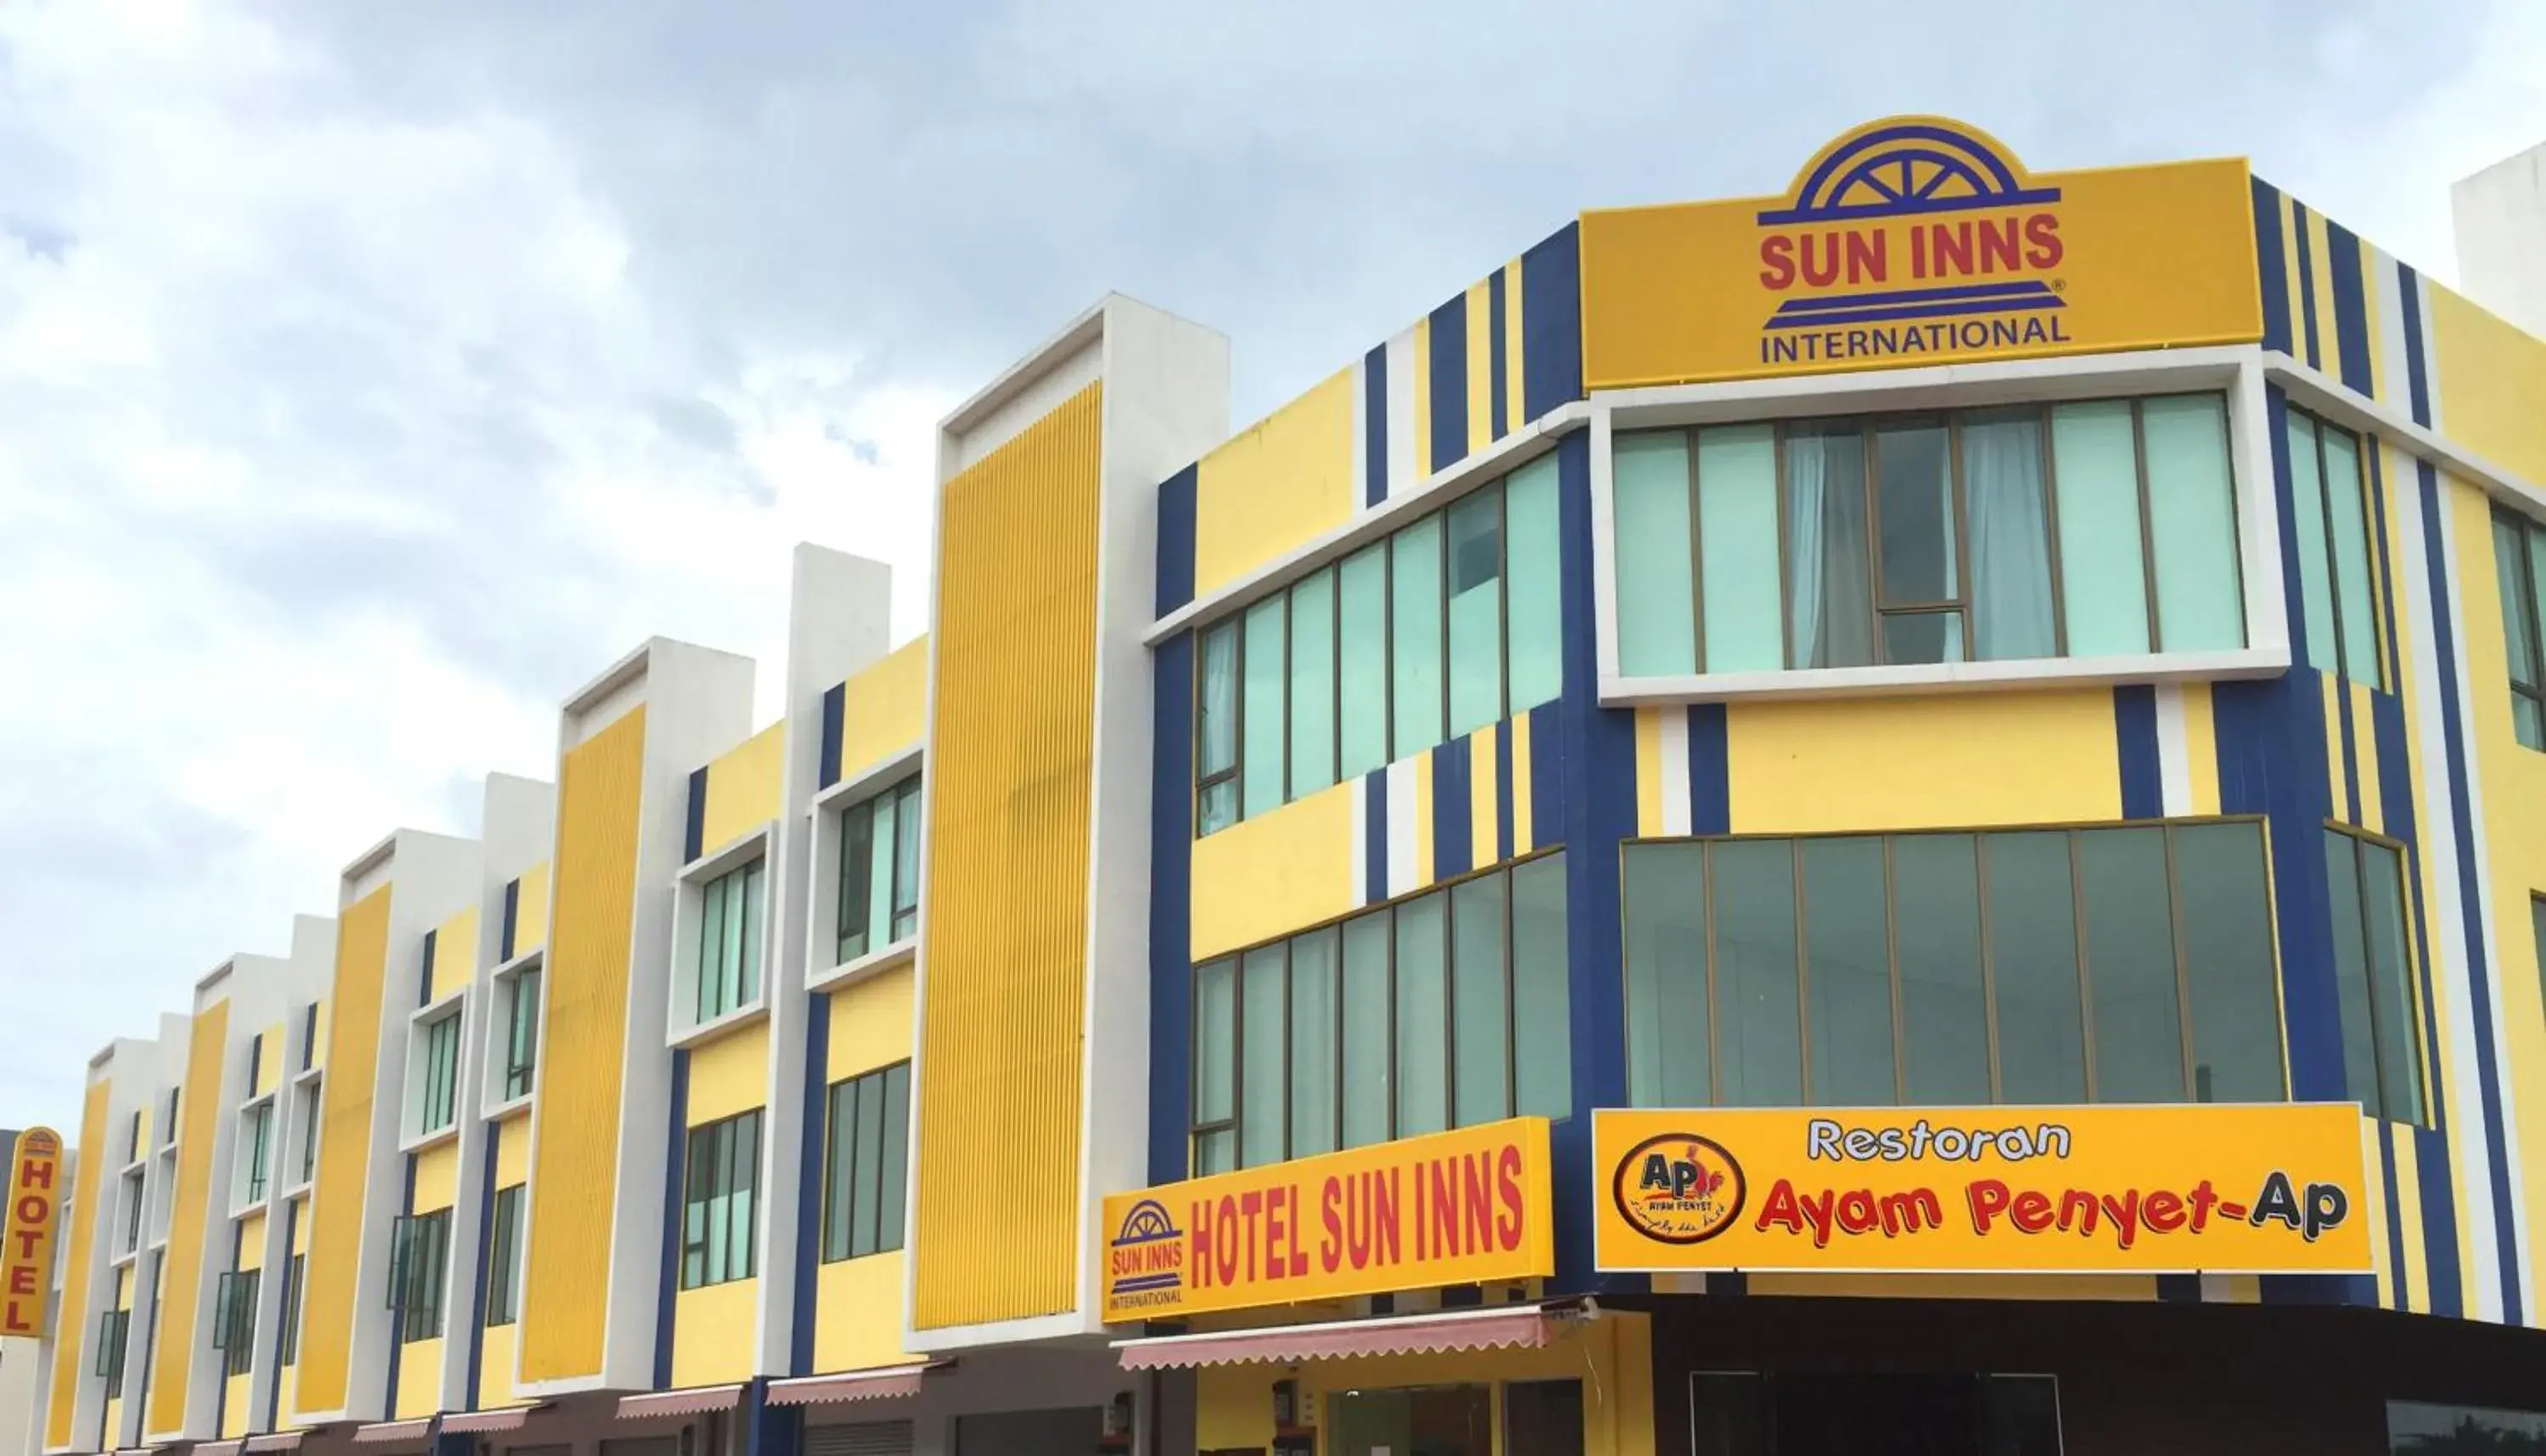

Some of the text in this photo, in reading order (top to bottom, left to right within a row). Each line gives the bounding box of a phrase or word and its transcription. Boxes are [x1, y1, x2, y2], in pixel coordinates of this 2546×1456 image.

[1760, 213, 2064, 290] SUN INNS
[1761, 315, 2071, 363] INTERNATIONAL
[1807, 1118, 2072, 1162] Restoran
[1640, 1153, 1698, 1200] Ap
[1191, 1144, 1523, 1288] HOTEL SUN INNS
[1753, 1170, 2350, 1250] Ayam Penyet-Ap
[6, 1159, 53, 1330] HOTEL
[1112, 1240, 1183, 1276] SUN INNS
[1109, 1289, 1183, 1310] INTERNATIONAL
